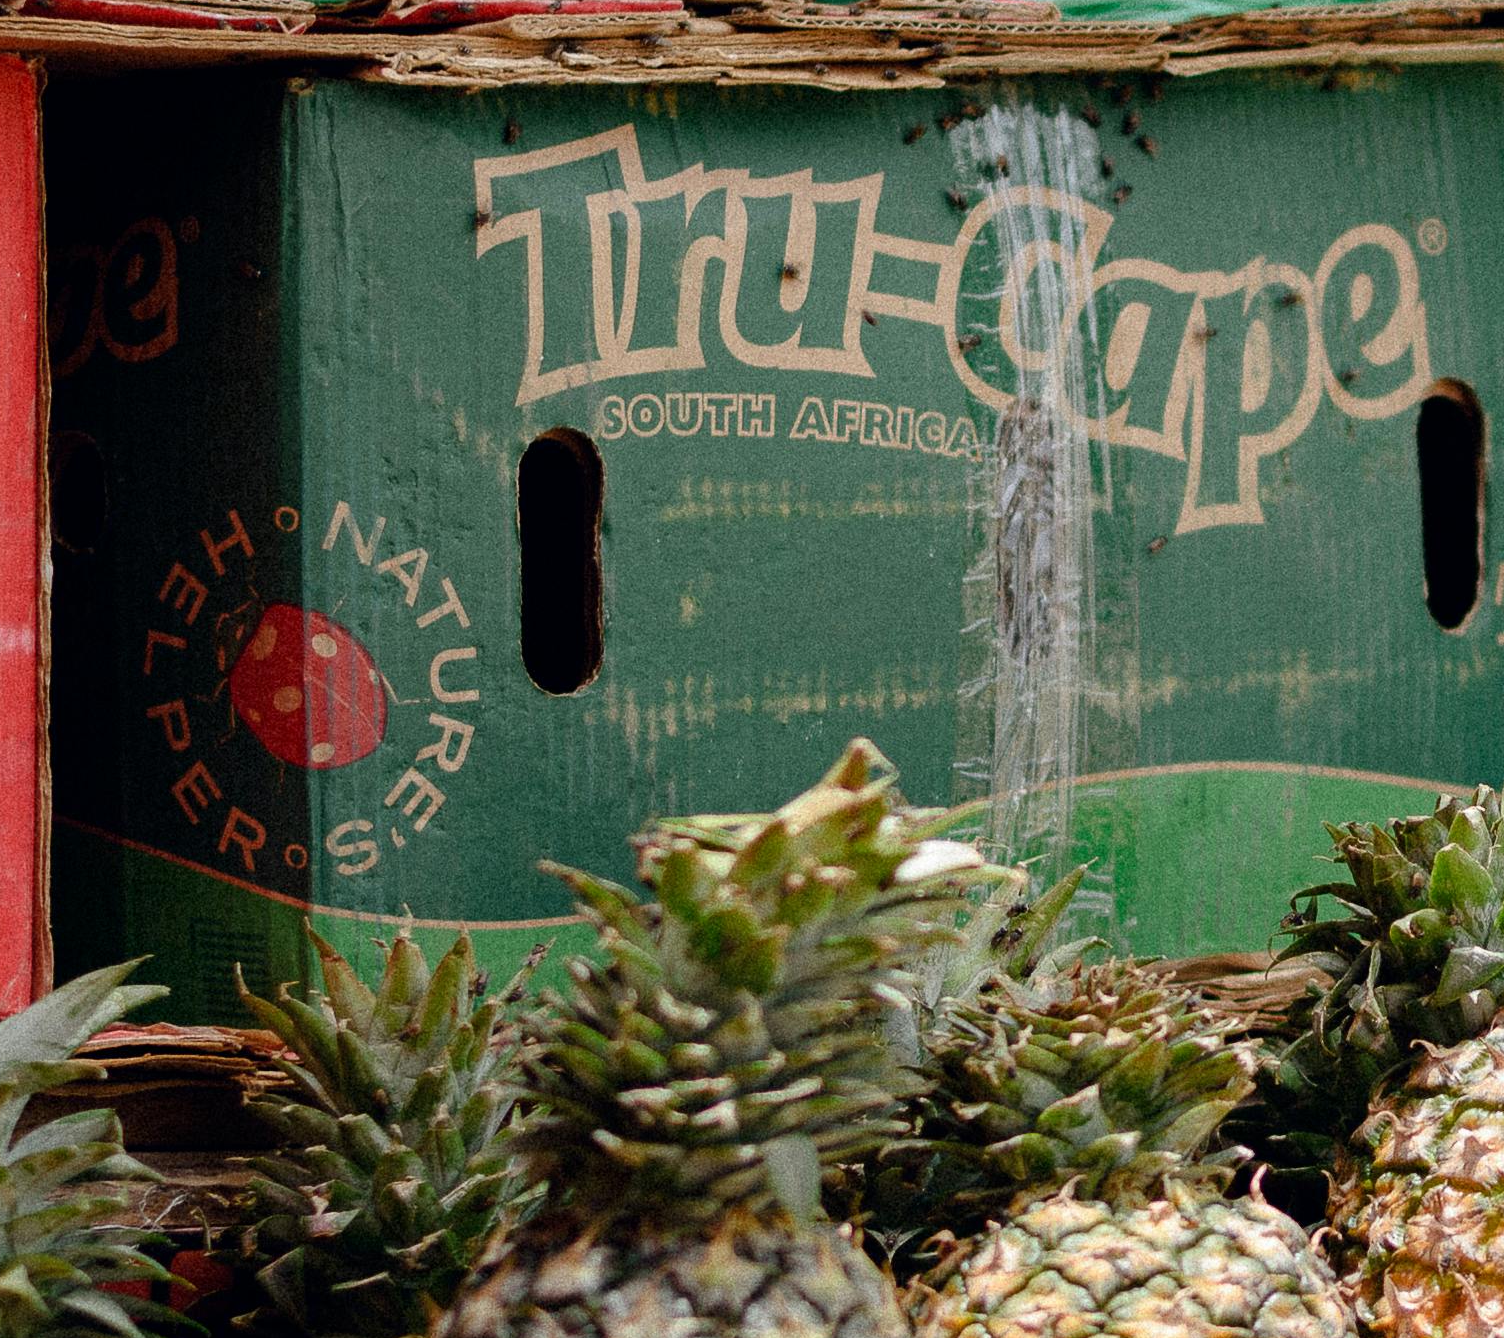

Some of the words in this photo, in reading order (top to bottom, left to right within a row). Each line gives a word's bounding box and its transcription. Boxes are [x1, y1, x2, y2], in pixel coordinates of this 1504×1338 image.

[473, 122, 1433, 535] Tru-Cape
[599, 392, 776, 440] SOUTH
[789, 396, 984, 462] AFRICA
[143, 508, 267, 873] HELPER
